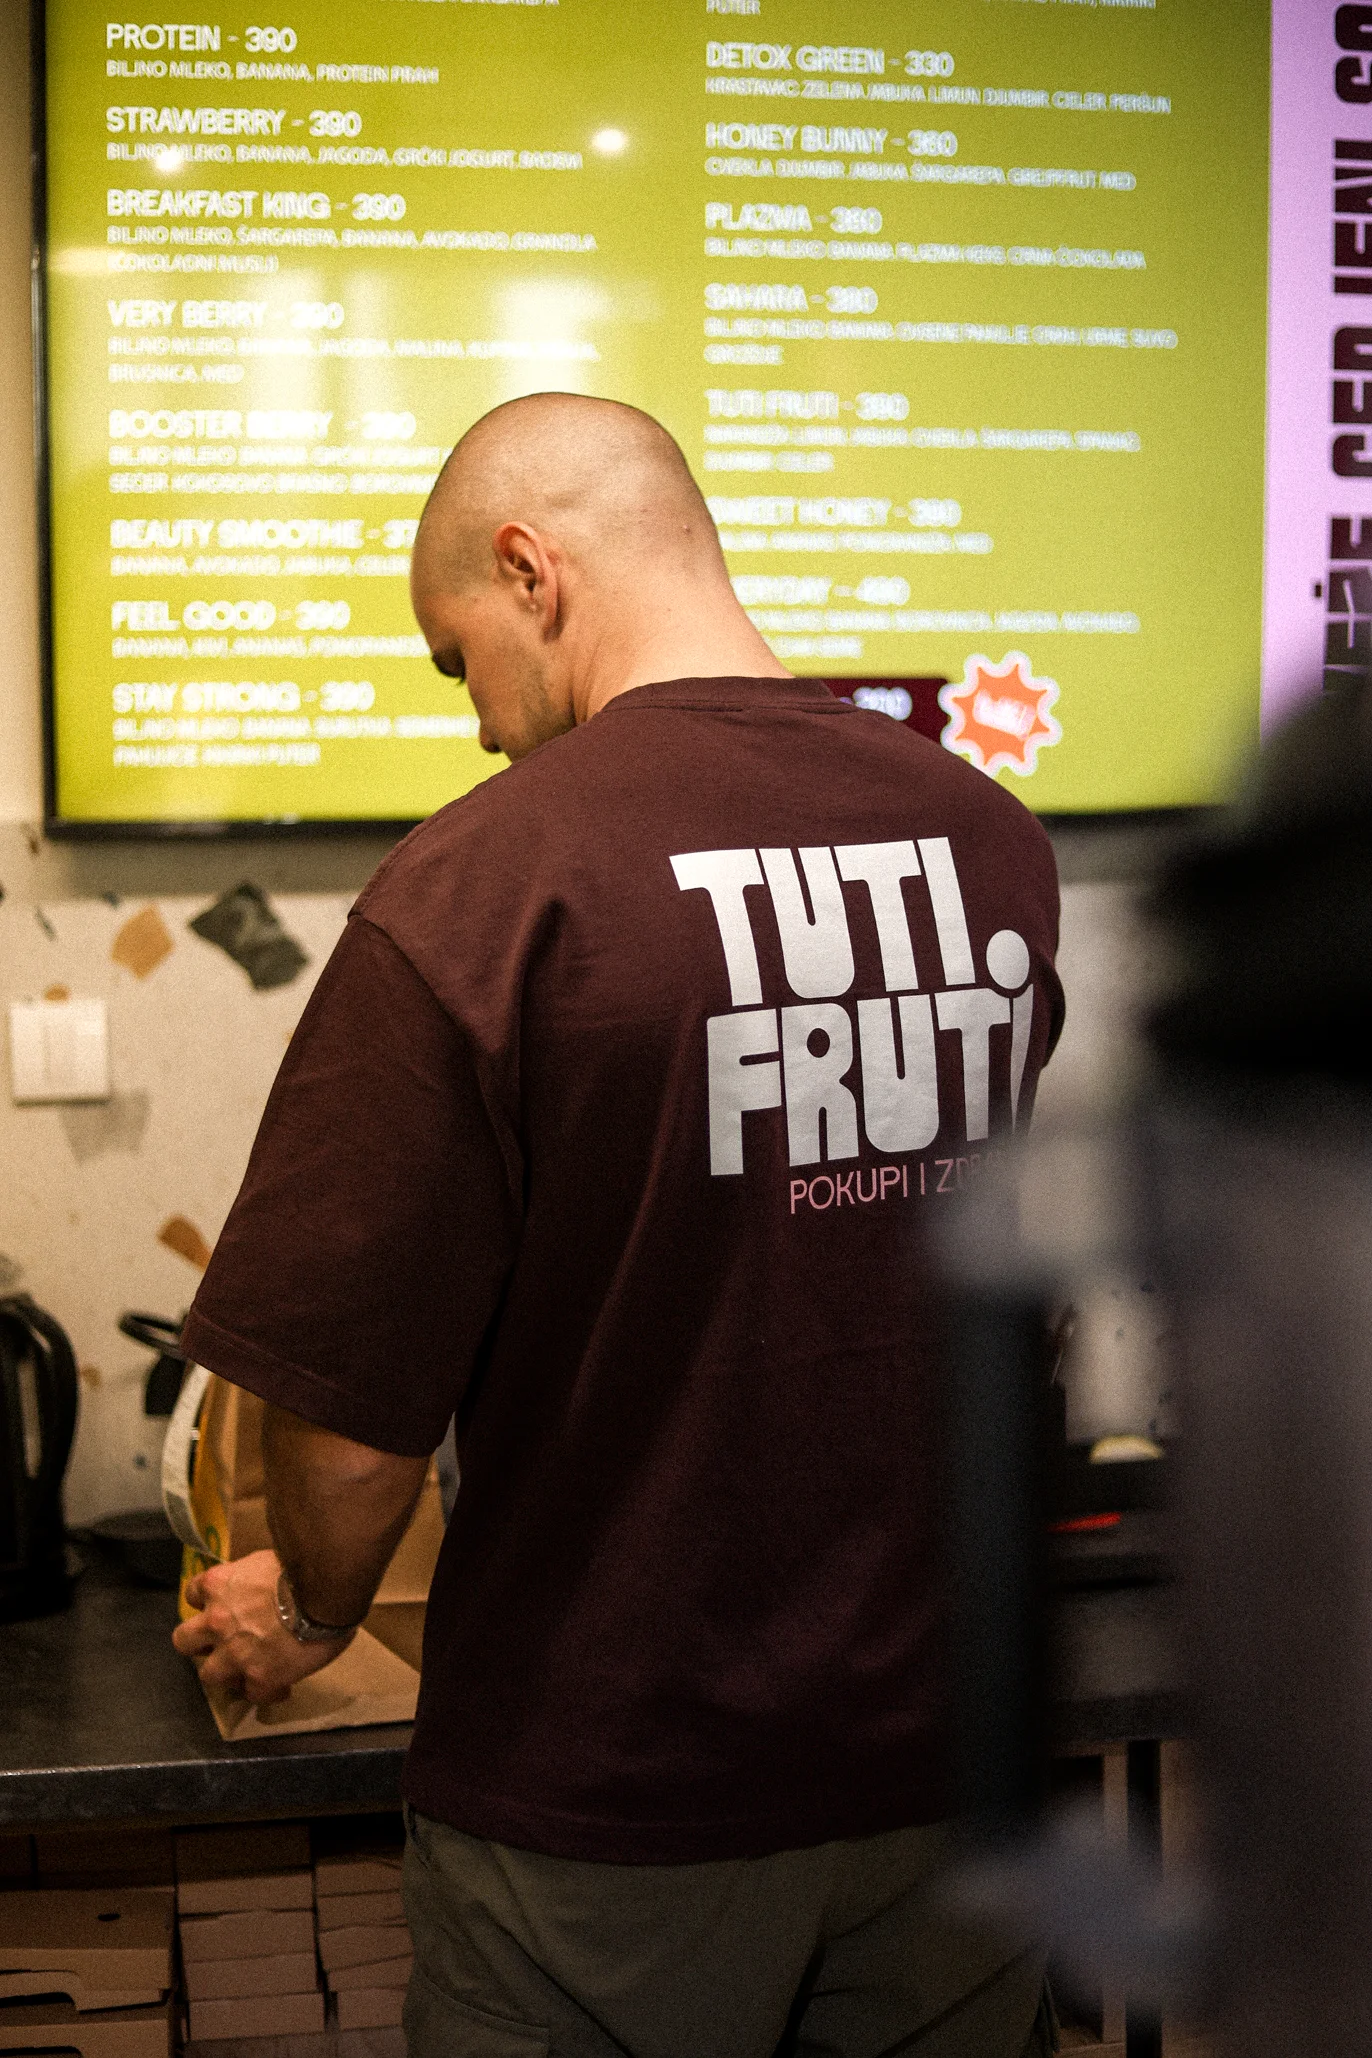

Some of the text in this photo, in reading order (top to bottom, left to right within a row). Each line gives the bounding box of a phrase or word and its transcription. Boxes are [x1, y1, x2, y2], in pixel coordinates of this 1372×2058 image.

[106, 23, 220, 50] PROTEIN
[245, 27, 297, 53] 390
[706, 42, 792, 71] DETOX
[797, 45, 885, 74] GREEN
[905, 51, 955, 77] 330
[106, 106, 286, 135] STRAWBERRY
[309, 110, 361, 137] 390
[706, 123, 798, 151] HONEY
[801, 125, 888, 154] BUNNY
[106, 189, 259, 218] BREAKFAST
[262, 192, 331, 220] KING
[704, 202, 813, 231] PLAZMA
[108, 300, 177, 328] VERY
[182, 301, 269, 328] BERRY
[108, 410, 242, 439] BOOSTER
[111, 520, 214, 549] BEAUTY
[218, 520, 363, 549] SMOOTHIE
[111, 601, 178, 631] FEEL
[183, 601, 276, 630] GOOD
[112, 682, 178, 712] STAY
[182, 682, 301, 712] STRONG
[790, 1164, 908, 1214] POKUPI
[919, 1162, 926, 1195] I
